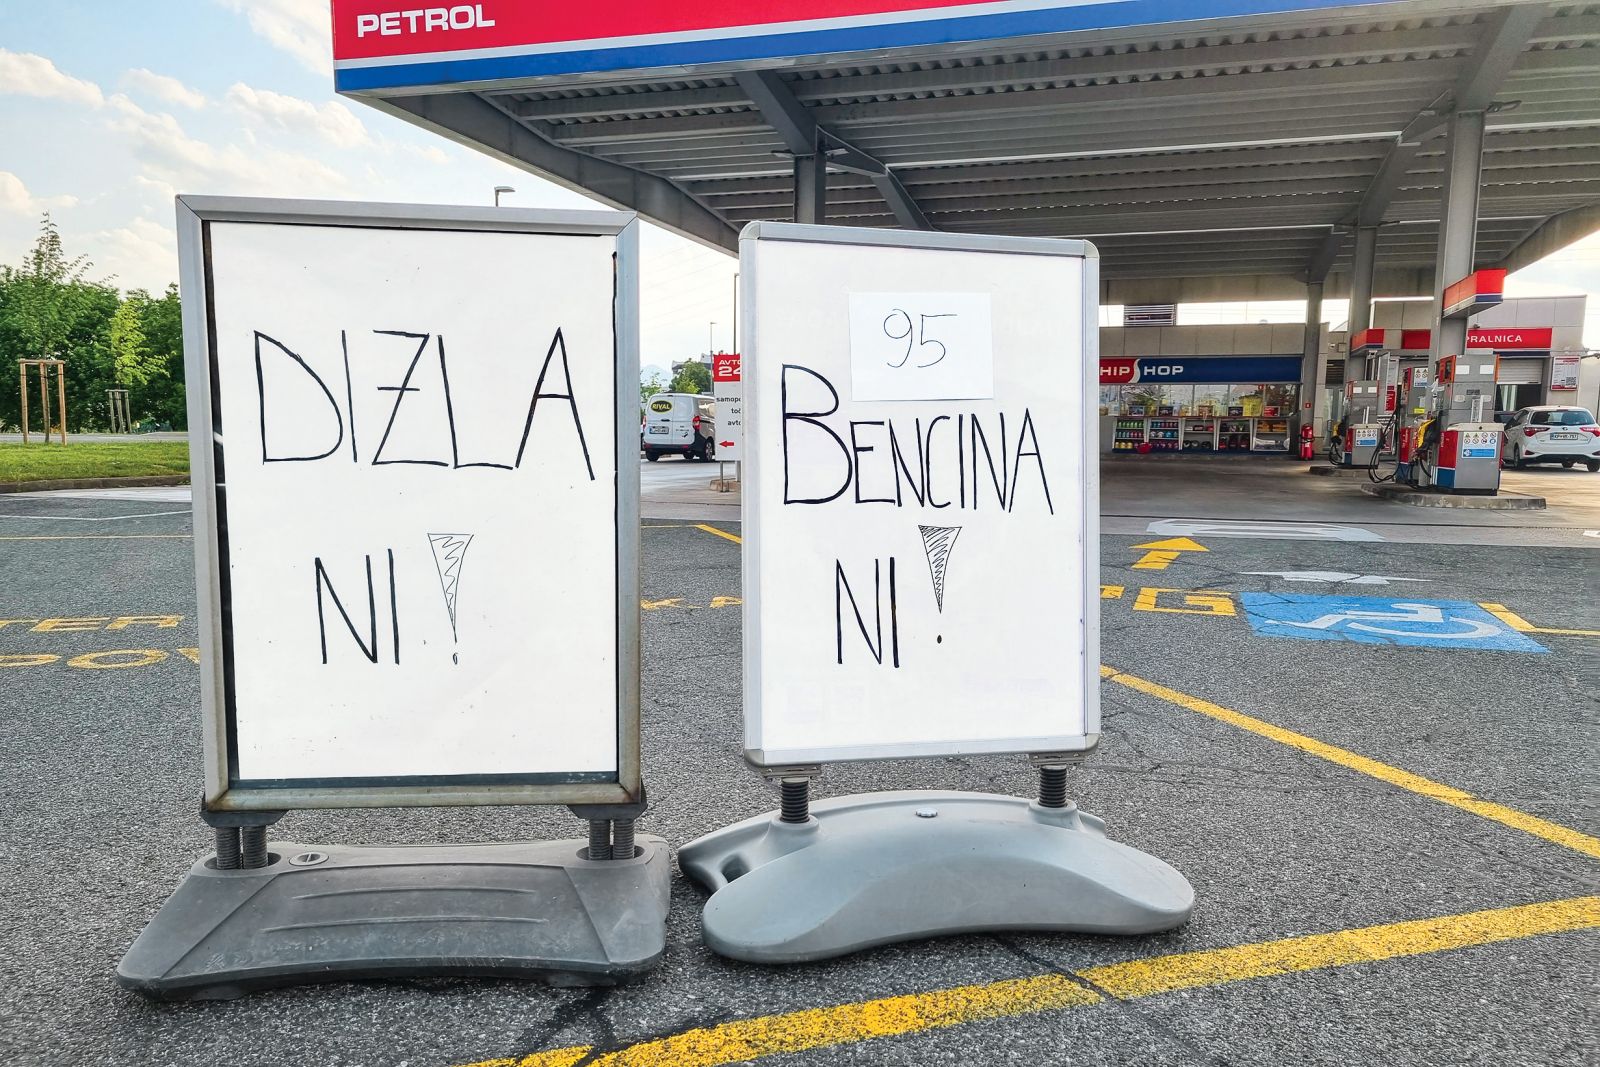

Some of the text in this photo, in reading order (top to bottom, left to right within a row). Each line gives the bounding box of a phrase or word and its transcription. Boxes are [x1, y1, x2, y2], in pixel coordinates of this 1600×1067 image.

[356, 3, 496, 38] PETROL
[883, 308, 959, 368] 95
[1100, 366, 1130, 376] HIP
[253, 326, 596, 481] DIZLA
